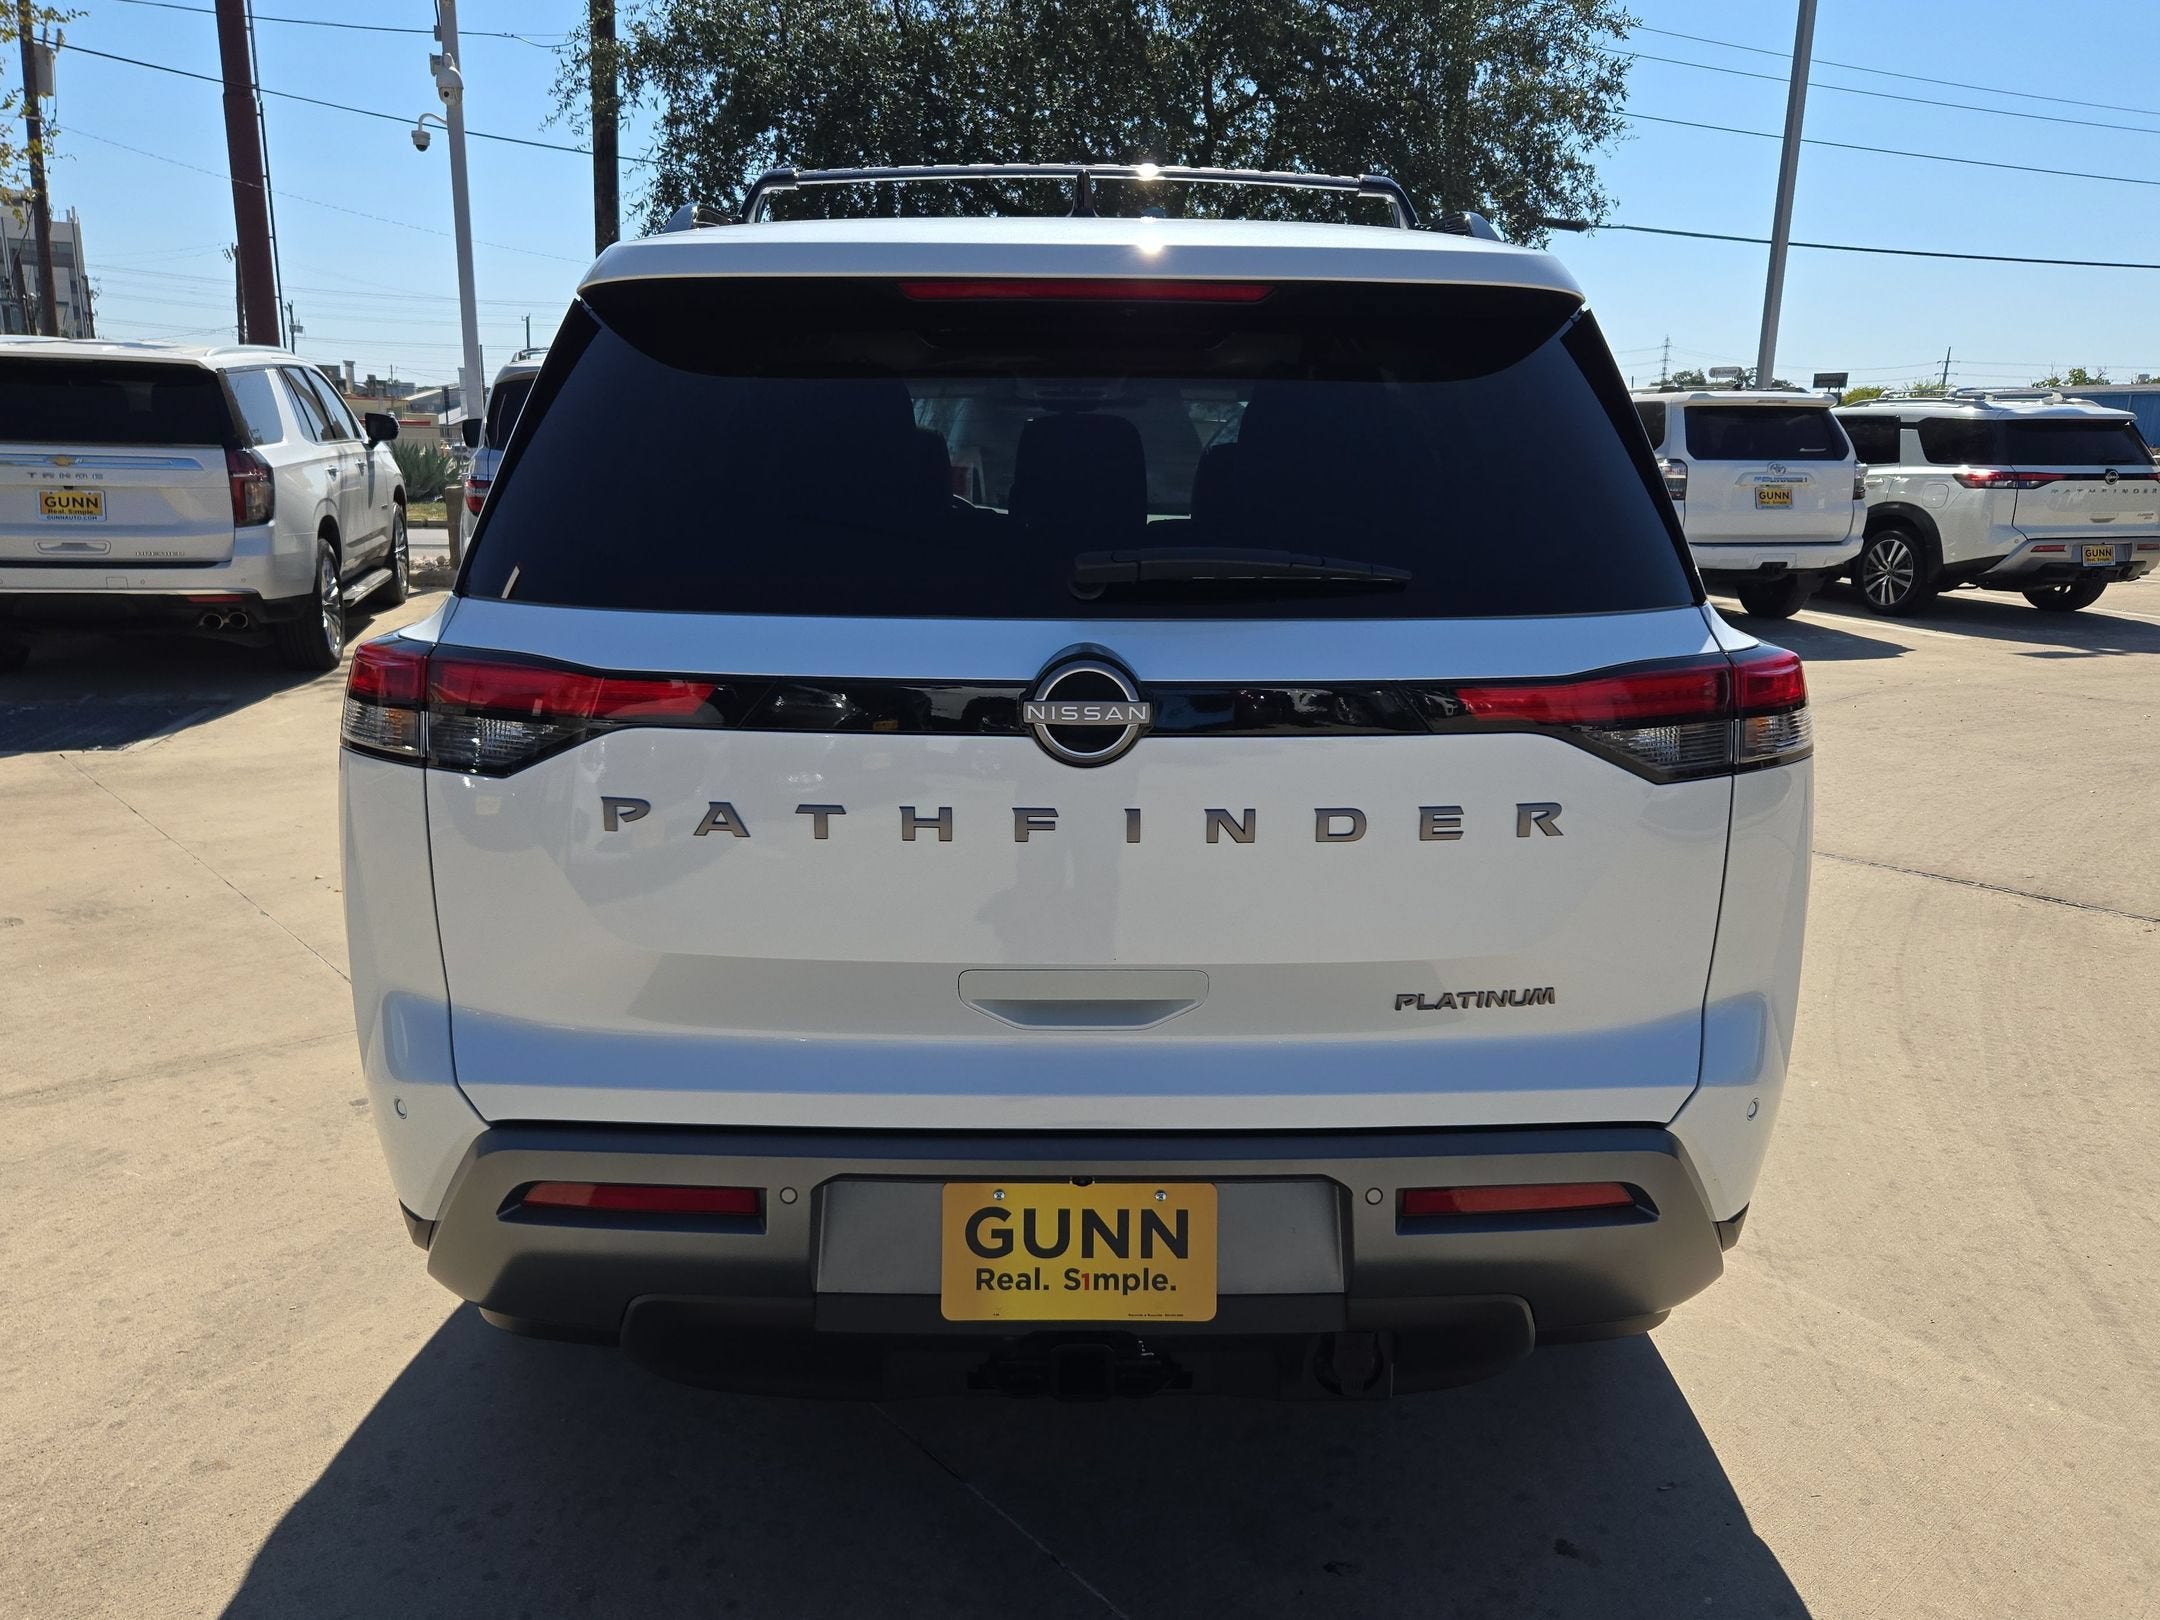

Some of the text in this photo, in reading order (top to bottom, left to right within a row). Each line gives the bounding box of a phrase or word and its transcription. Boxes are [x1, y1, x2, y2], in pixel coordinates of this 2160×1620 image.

[44, 496, 98, 509] GUNN
[1759, 491, 1790, 500] GUNN
[2085, 549, 2112, 557] GUNN
[1027, 705, 1146, 721] NISSAN
[601, 796, 1564, 844] PATHFINDER
[1395, 987, 1556, 1011] PLATINUM
[965, 1206, 1189, 1259] GUNN
[975, 1267, 1050, 1291] Real.
